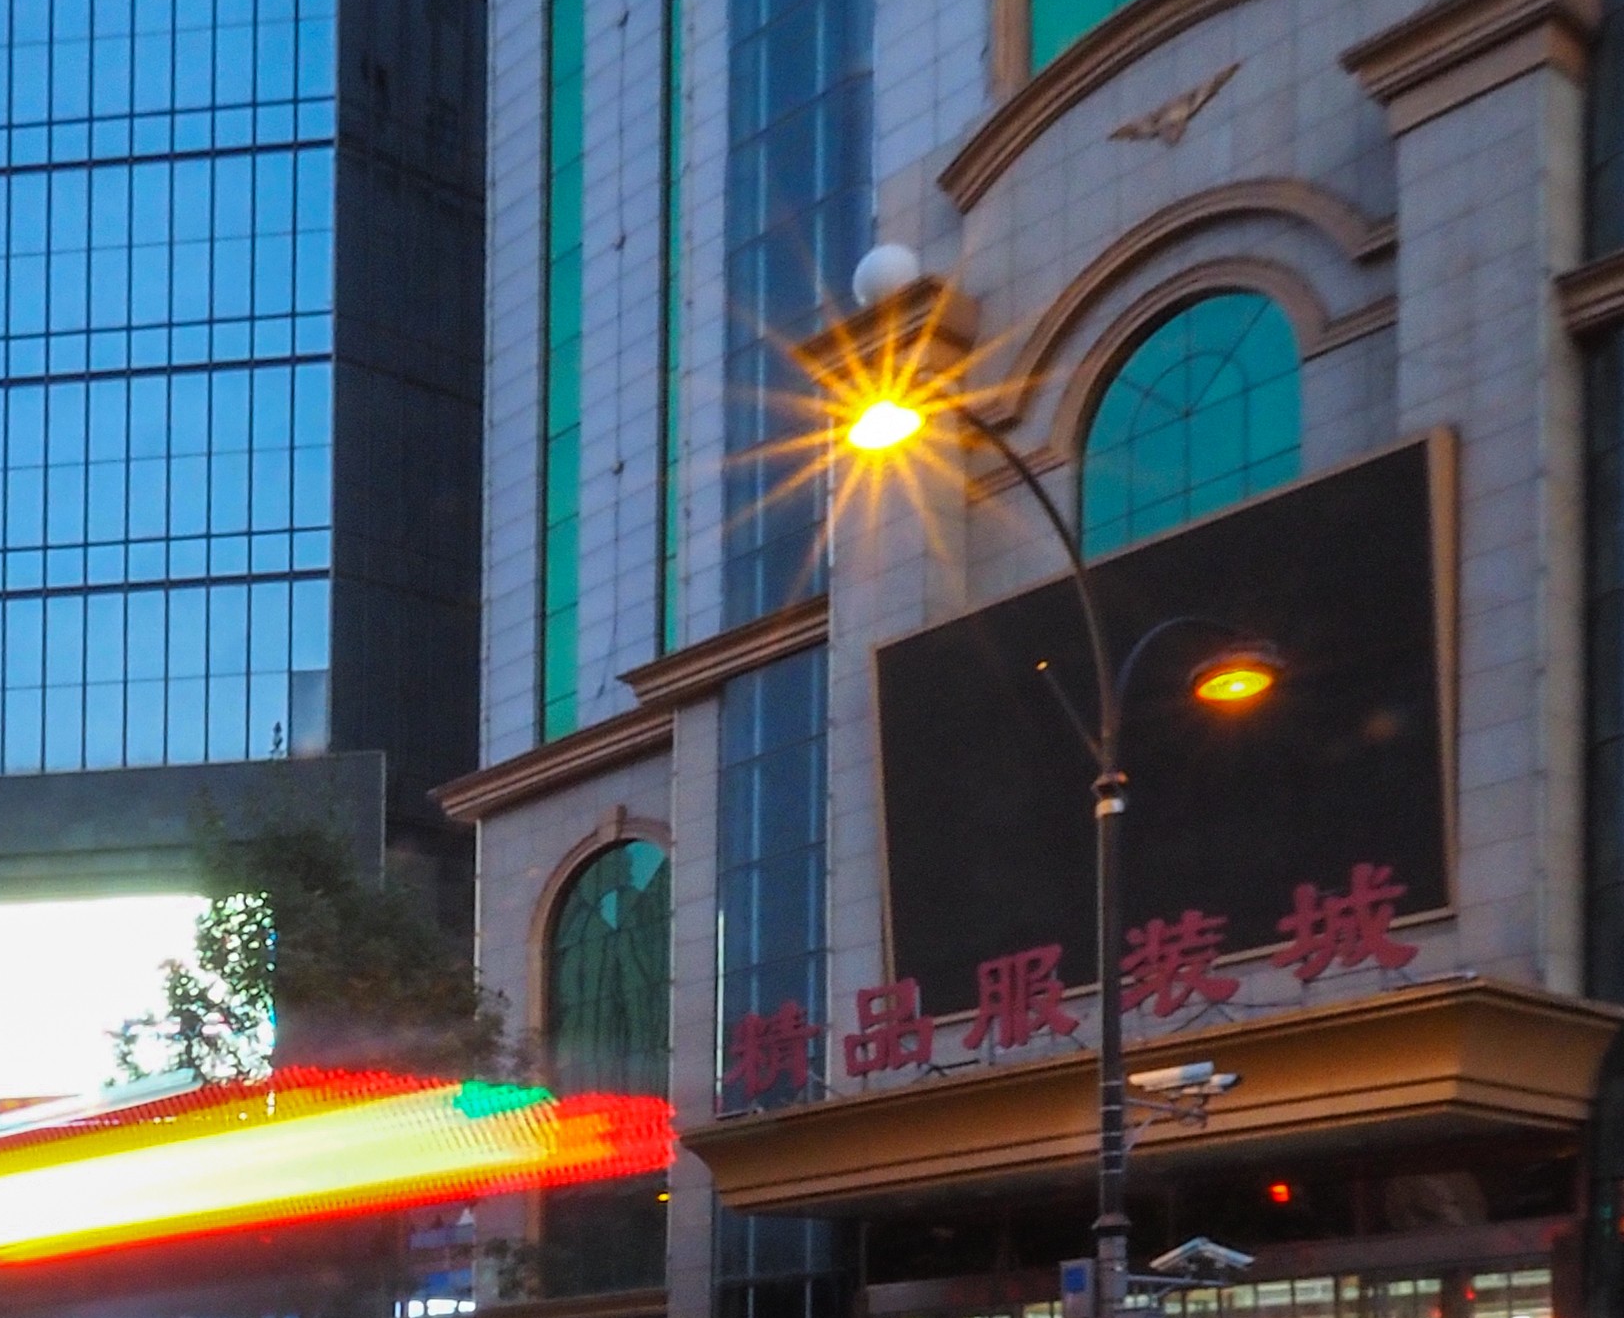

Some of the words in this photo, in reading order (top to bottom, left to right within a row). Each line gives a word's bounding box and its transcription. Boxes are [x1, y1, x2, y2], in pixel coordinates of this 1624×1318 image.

[722, 863, 1418, 1099] 精品服装城
